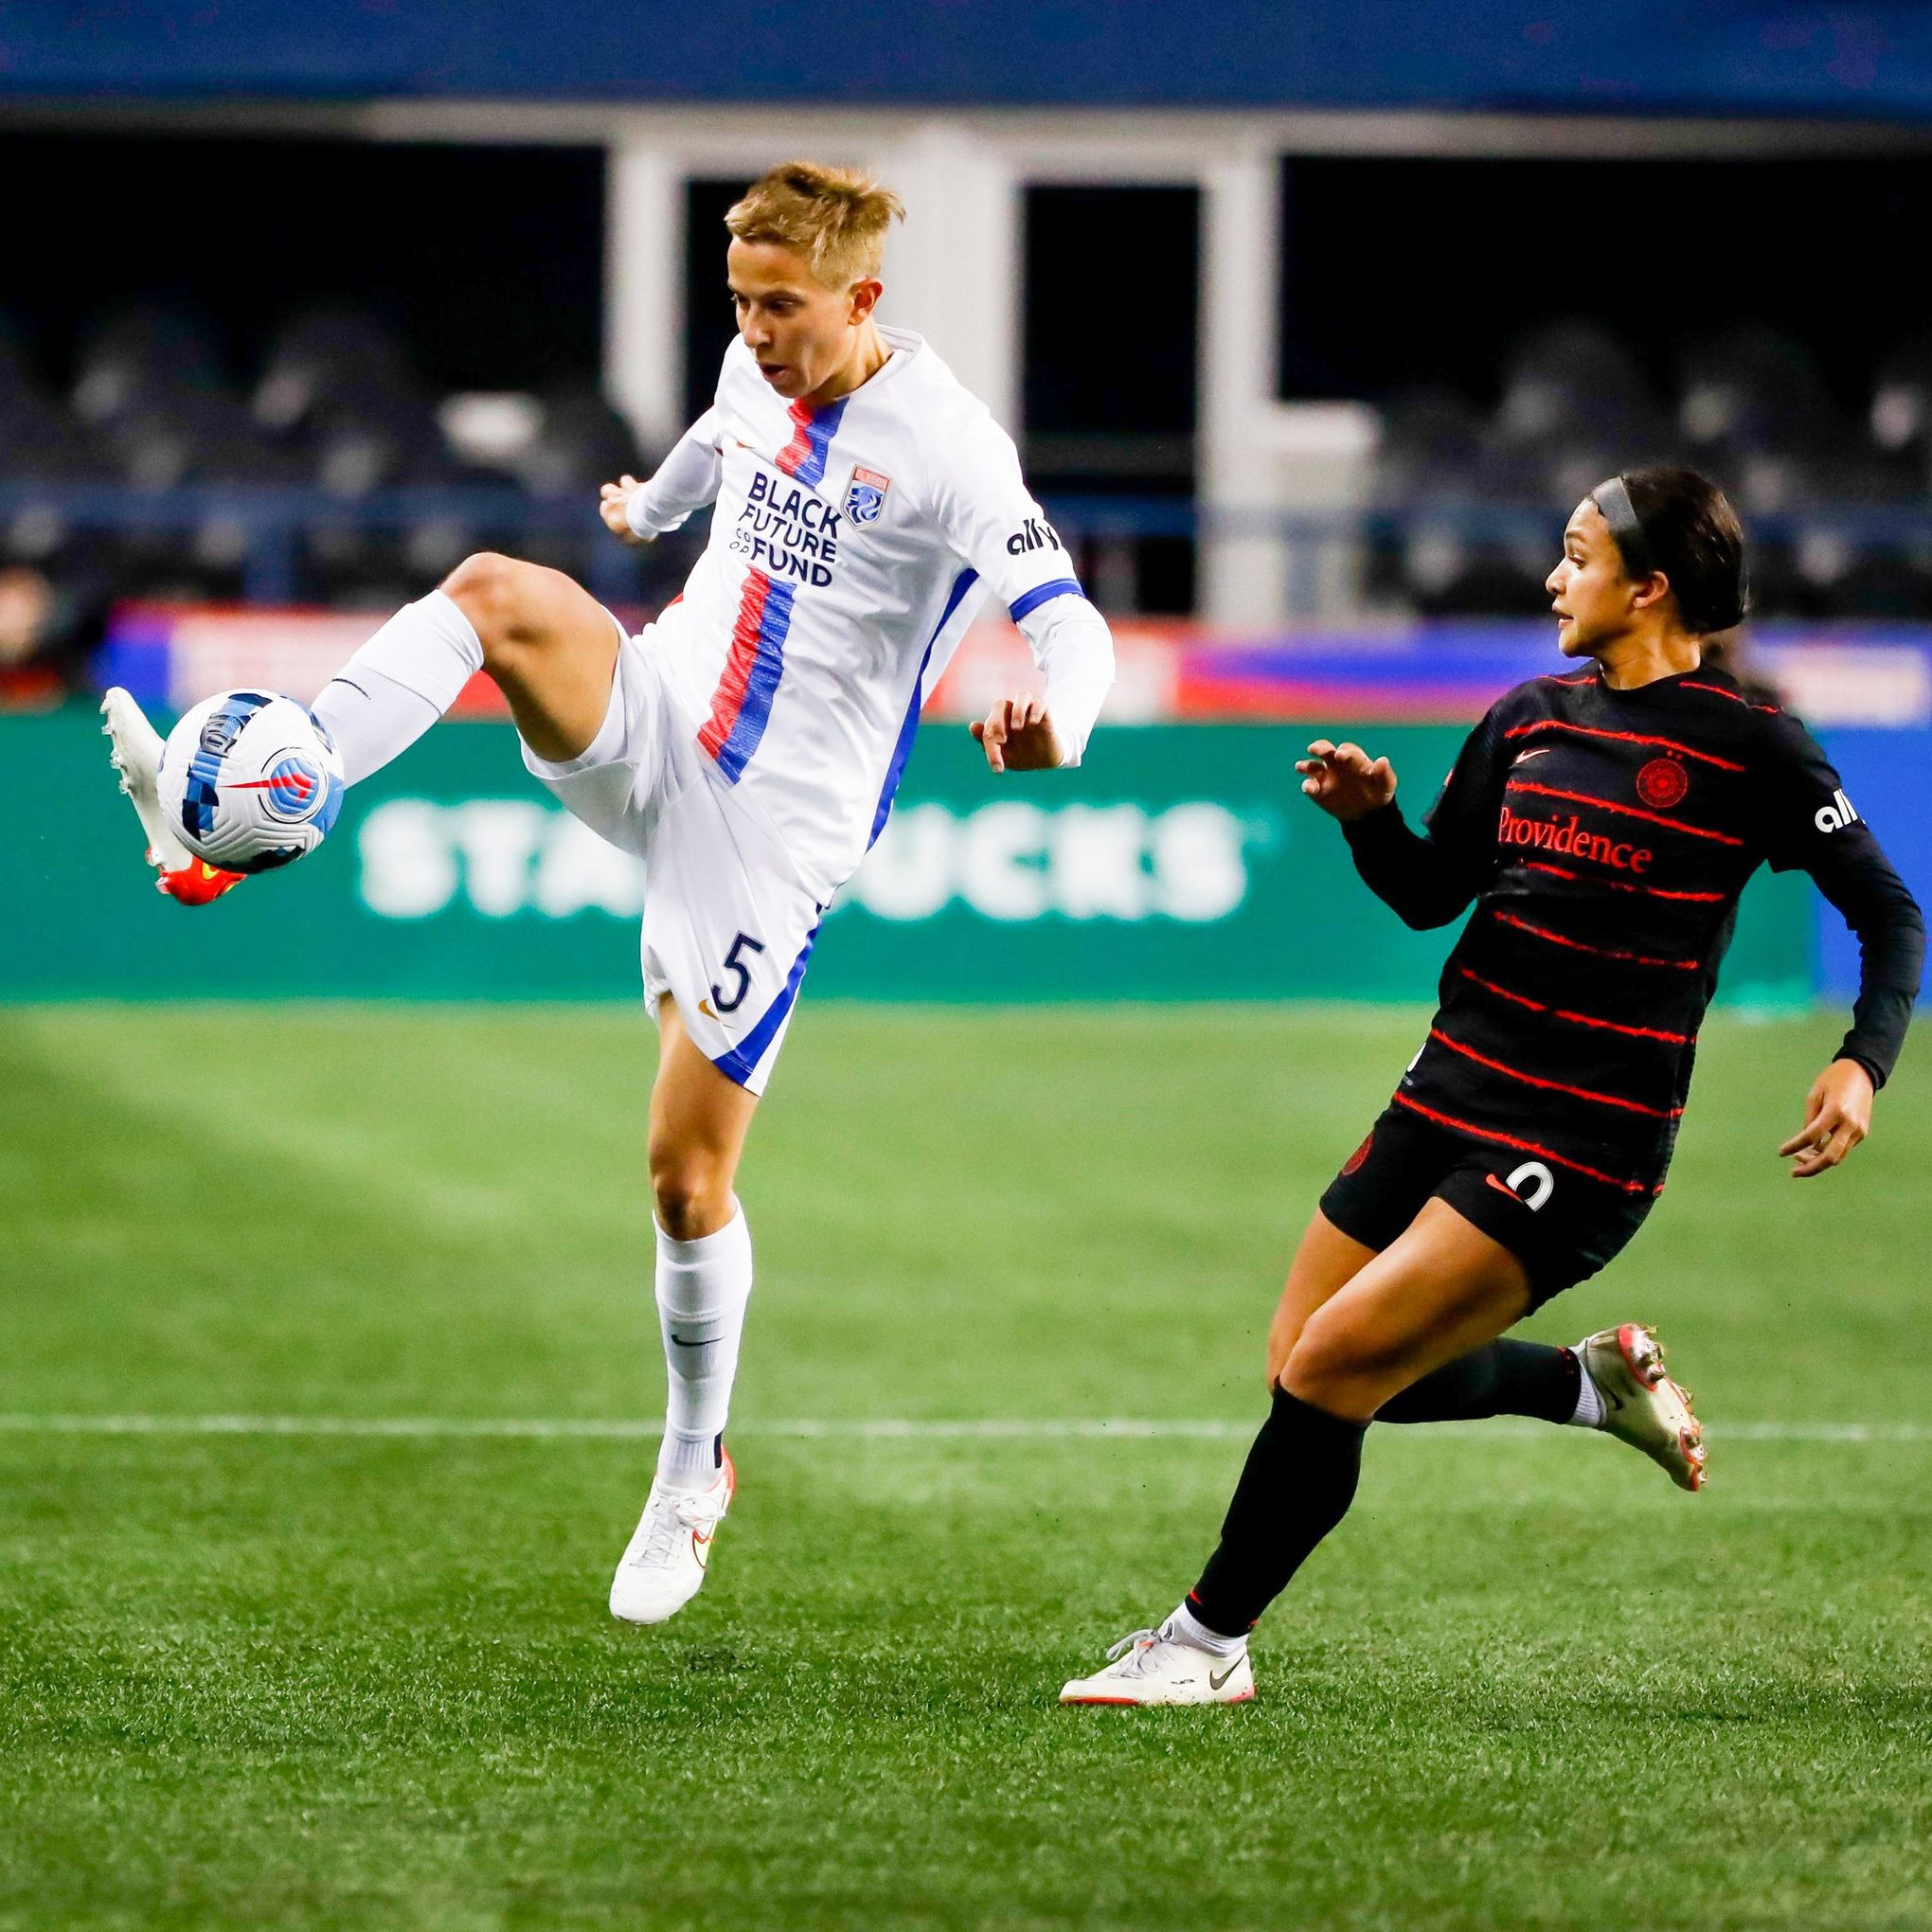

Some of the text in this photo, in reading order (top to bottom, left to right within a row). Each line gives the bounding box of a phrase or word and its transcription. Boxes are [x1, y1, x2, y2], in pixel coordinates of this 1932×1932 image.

[739, 502, 837, 564] FUTURE
[747, 471, 843, 540] BLACK
[1007, 517, 1059, 555] ally
[750, 536, 832, 587] FUND
[1497, 806, 1653, 874] Providence
[1815, 787, 1867, 833] all
[358, 797, 1248, 920] STAUCKS
[710, 929, 766, 1014] 5
